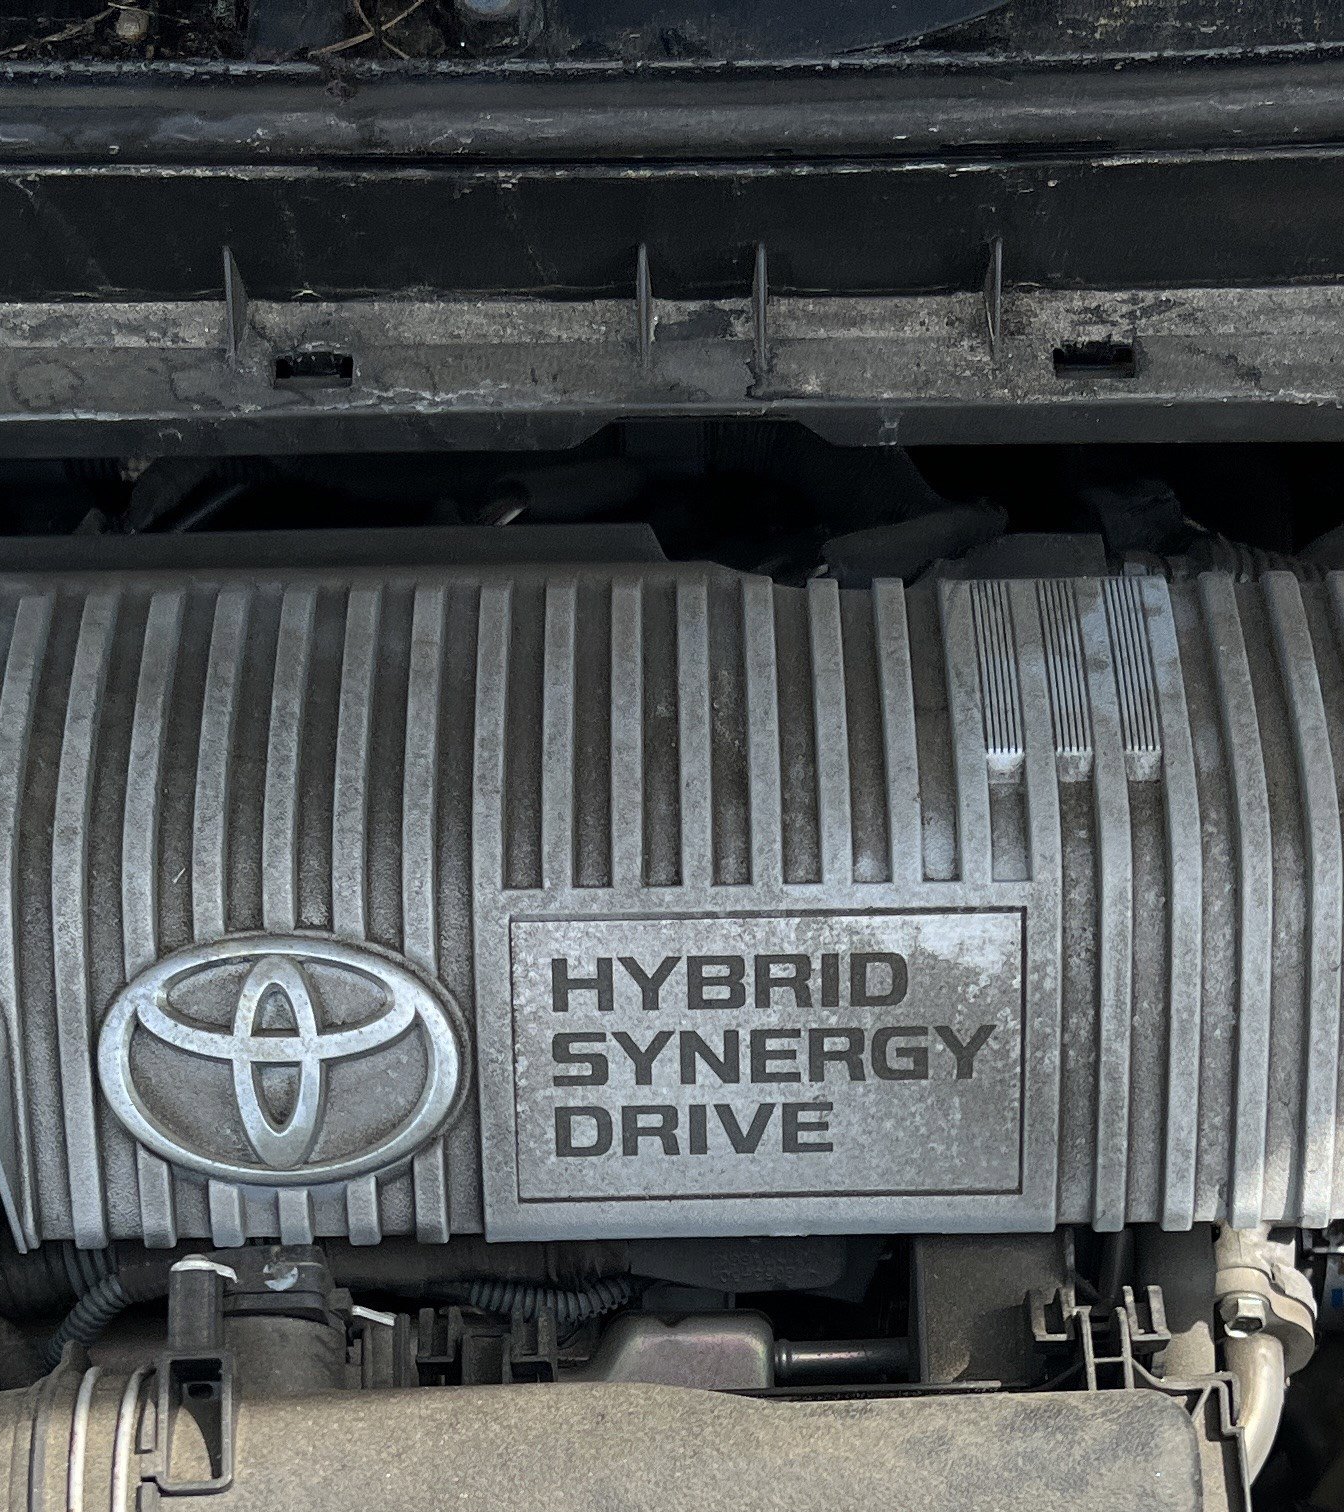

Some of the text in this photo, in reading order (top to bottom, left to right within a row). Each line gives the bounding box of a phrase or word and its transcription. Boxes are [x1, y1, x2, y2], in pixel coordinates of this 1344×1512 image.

[551, 951, 908, 1013] HYBRID
[551, 1024, 997, 1087] SYNERGY
[555, 1101, 835, 1158] DRIVE
